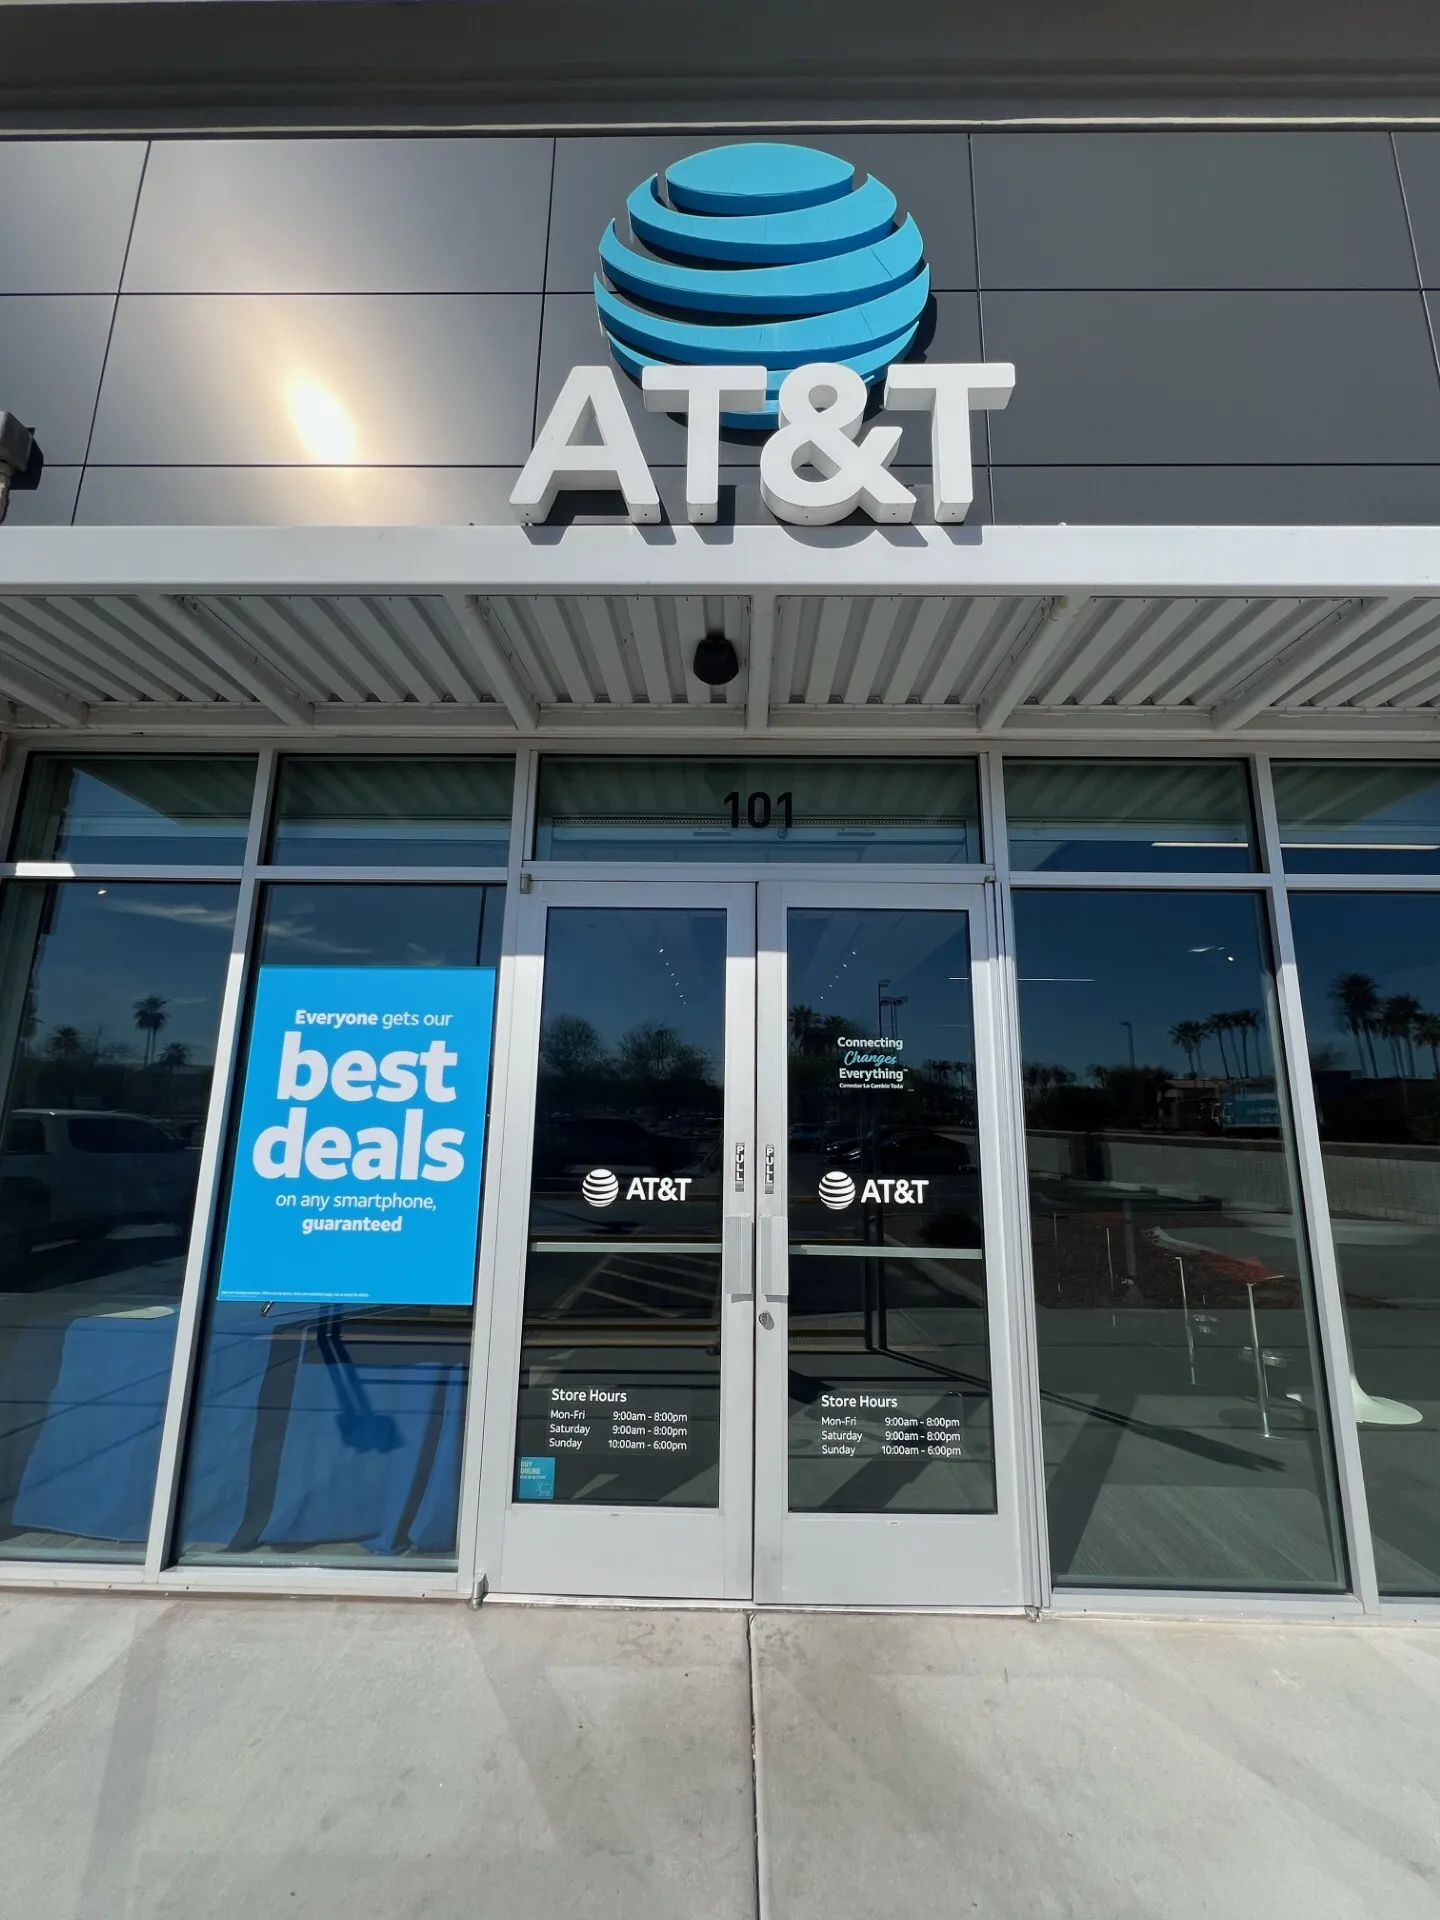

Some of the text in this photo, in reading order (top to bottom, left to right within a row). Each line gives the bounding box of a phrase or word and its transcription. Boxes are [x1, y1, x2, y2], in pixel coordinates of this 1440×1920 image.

[509, 362, 1016, 526] AT&T
[723, 791, 792, 829] 101
[295, 1009, 453, 1030] Everyone gets our
[837, 1036, 904, 1050] Connecting
[276, 1031, 458, 1103] best
[844, 1050, 898, 1067] Changes
[839, 1068, 904, 1082] Everything
[253, 1107, 465, 1182] deals
[735, 1145, 745, 1182] PULL
[765, 1148, 775, 1184] PULL
[626, 1177, 693, 1202] AT&T
[860, 1179, 930, 1204] AT&T
[275, 1193, 437, 1212] on any smartphone,
[302, 1216, 402, 1235] guaranteed
[551, 1388, 628, 1403] Store Hours
[821, 1395, 898, 1408] Store Hours
[550, 1410, 586, 1420] Mon-Fri
[612, 1411, 646, 1421] 9:00am
[653, 1412, 688, 1424] 8:00pm
[821, 1416, 857, 1426] Mon-Fri
[885, 1417, 918, 1427] 9:00am
[926, 1417, 960, 1429] 8:00pm
[550, 1424, 591, 1436] Saturday
[612, 1425, 646, 1435] 9:00am
[653, 1426, 687, 1438] 8:00pm
[821, 1431, 863, 1443] Saturday
[885, 1431, 919, 1441] 9:00am
[926, 1431, 961, 1443] 8:00pm
[549, 1438, 583, 1450] Sunday
[608, 1439, 645, 1449] 10:00am
[653, 1440, 687, 1452] 6:00pm
[821, 1445, 856, 1457] Sunday
[882, 1445, 919, 1455] 10:00am
[927, 1446, 962, 1457] 6:00pm
